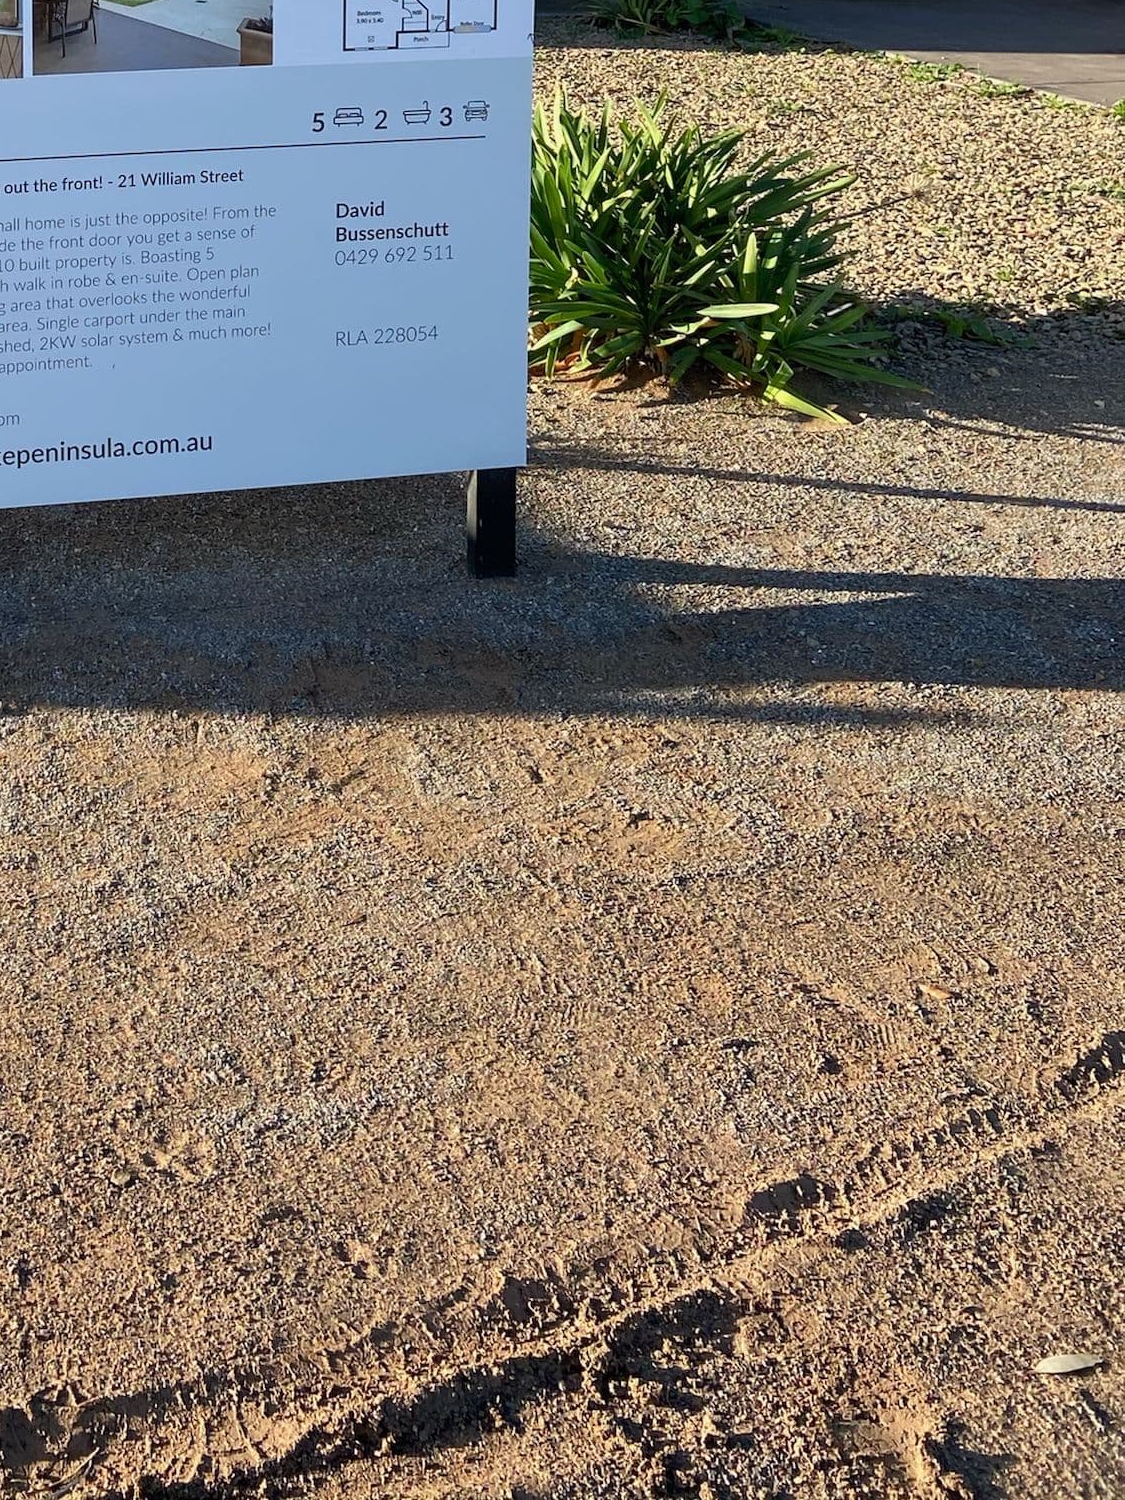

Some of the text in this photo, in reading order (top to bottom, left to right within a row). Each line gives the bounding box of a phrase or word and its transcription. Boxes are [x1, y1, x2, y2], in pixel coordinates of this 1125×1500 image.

[311, 106, 453, 133] 5 2 3
[3, 180, 29, 194] out
[32, 178, 57, 192] the
[61, 175, 102, 191] front!
[117, 173, 136, 188] 21
[140, 171, 195, 186] William
[199, 168, 244, 184] Street
[24, 216, 65, 231] home
[69, 214, 81, 228] is
[84, 213, 111, 230] just
[114, 211, 138, 226] the
[142, 207, 207, 226] opposite!
[212, 205, 249, 219] From
[253, 203, 276, 218] the
[335, 200, 384, 219] David
[20, 236, 44, 251] the
[48, 235, 84, 249] front
[88, 232, 122, 247] door
[125, 233, 153, 247] you
[156, 229, 180, 246] get
[183, 230, 192, 242] a
[196, 228, 236, 241] sense
[240, 223, 255, 239] of
[335, 221, 449, 242] Bussenschutt
[18, 256, 51, 271] built
[54, 253, 117, 272] property
[121, 251, 135, 265] is.
[140, 247, 201, 264] Boasting
[205, 246, 214, 260] 5
[334, 244, 454, 266] 0429 692 511
[12, 276, 46, 291] walk
[50, 275, 63, 289] in
[67, 273, 101, 288] robe
[104, 272, 117, 286] &
[120, 269, 182, 285] en-suite.
[186, 266, 225, 283] Open
[229, 264, 259, 281] plan
[9, 300, 41, 313] area
[45, 295, 75, 310] that
[78, 290, 147, 308] overlooks
[151, 288, 175, 303] the
[178, 283, 250, 301] wonderful
[36, 315, 79, 332] Single
[83, 311, 135, 329] carport
[139, 308, 181, 324] under
[184, 307, 208, 321] the
[212, 304, 245, 319] main
[39, 334, 76, 351] 2KW
[80, 332, 114, 348] solar
[118, 331, 168, 347] system
[171, 327, 184, 342] &
[188, 325, 227, 340] much
[230, 322, 270, 337] more!
[335, 324, 438, 346] RLA 228054
